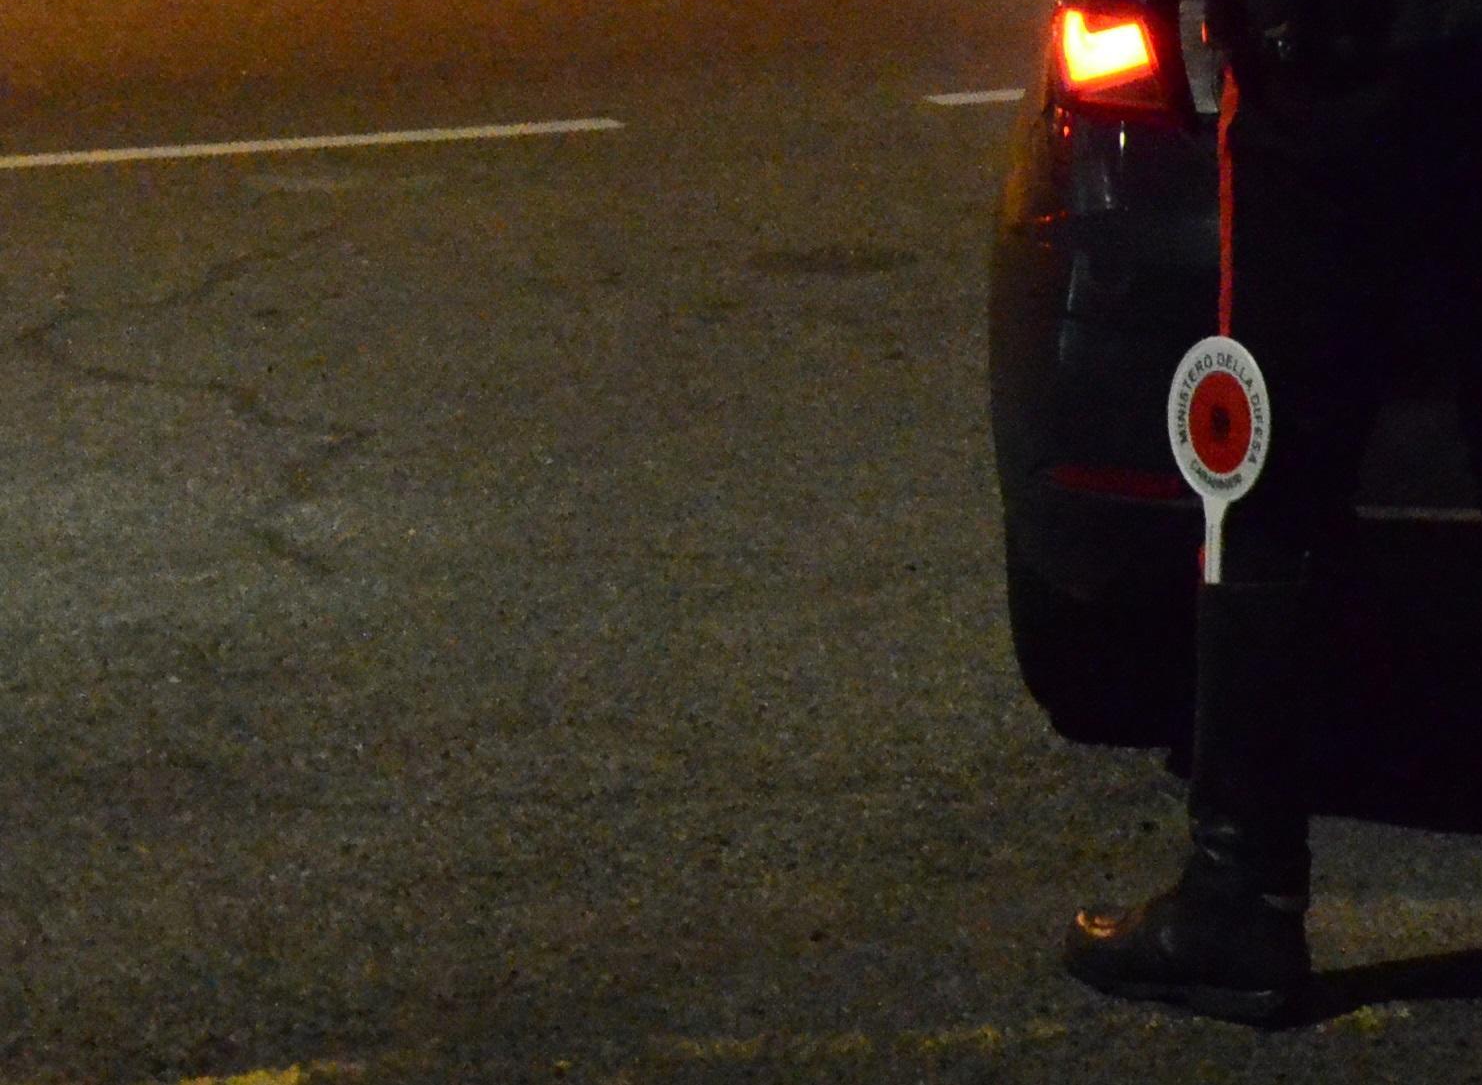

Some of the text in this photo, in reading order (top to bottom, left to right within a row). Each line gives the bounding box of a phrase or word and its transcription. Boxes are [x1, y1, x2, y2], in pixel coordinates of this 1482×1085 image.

[1177, 352, 1265, 463] MINISTERO DELLA DIFESA
